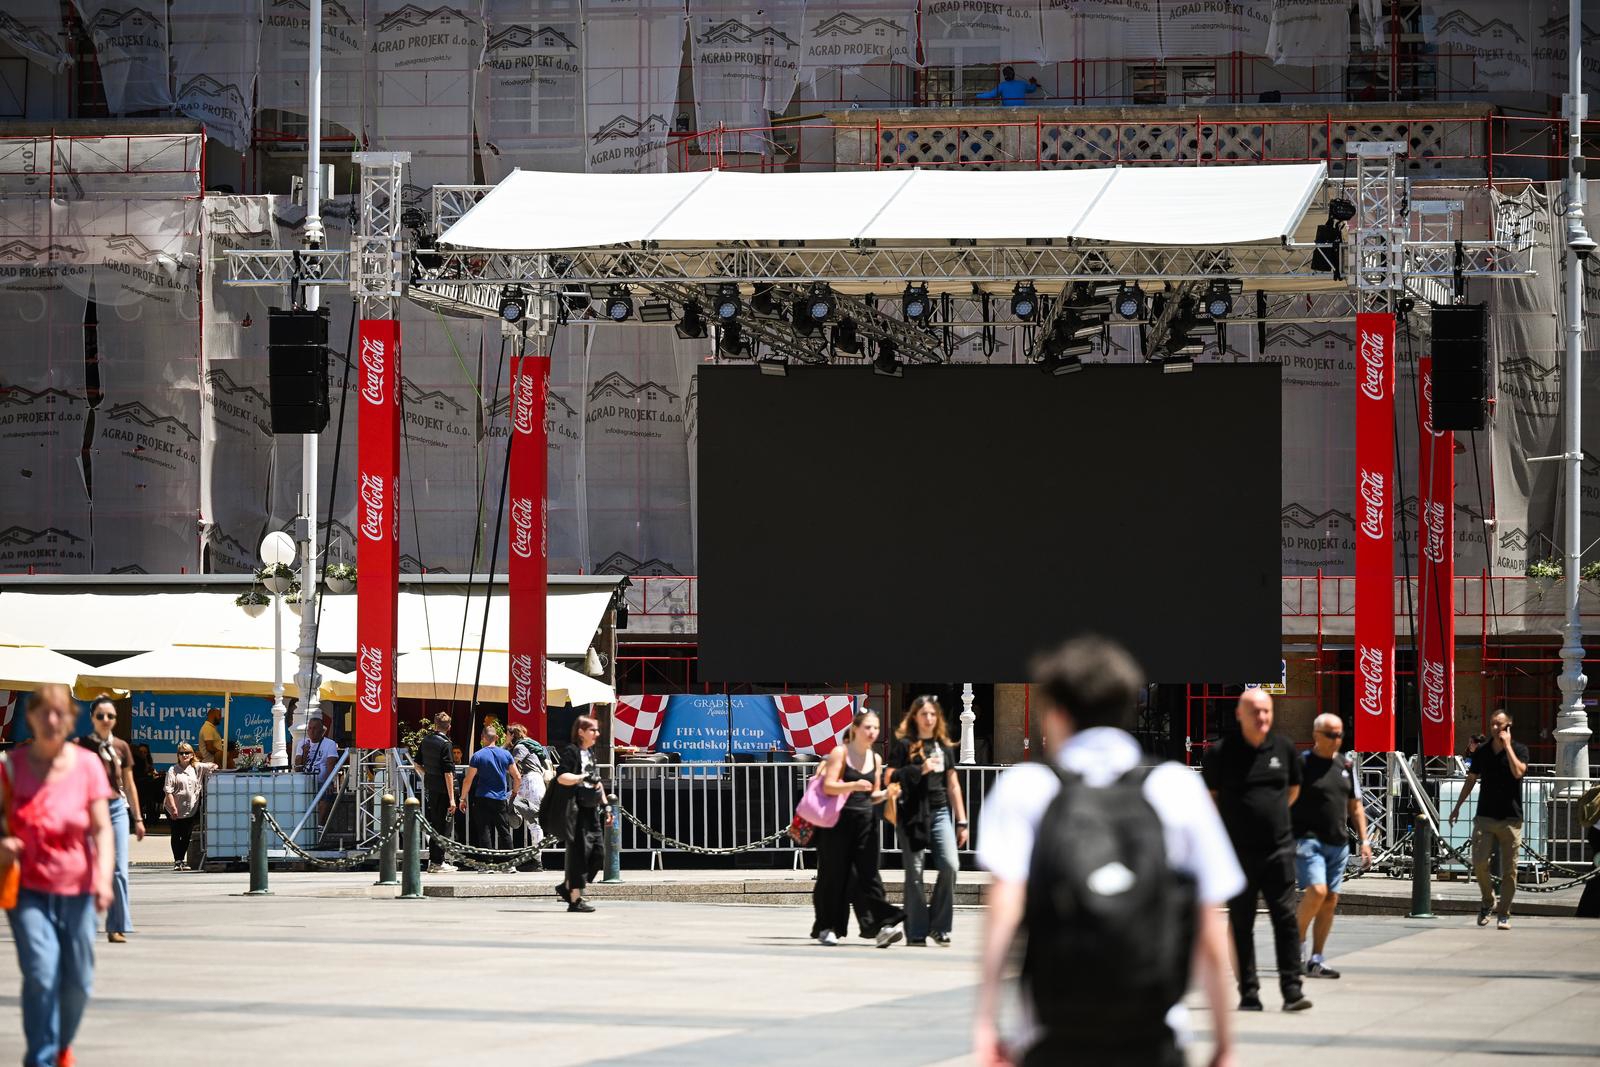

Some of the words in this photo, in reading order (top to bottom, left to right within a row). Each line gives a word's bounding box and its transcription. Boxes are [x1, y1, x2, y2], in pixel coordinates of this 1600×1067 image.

[927, 1, 960, 16] AGRAD
[963, 0, 1004, 15] PROJEKT
[1006, 6, 1032, 20] d.o.o.
[1169, 4, 1201, 21] AGRAD
[1203, 1, 1243, 15] PROJEKT
[267, 15, 299, 31] AGRAD
[339, 31, 360, 50] d.o.o.
[370, 39, 406, 54] AGRAD
[408, 34, 450, 50] PROJEKT
[453, 34, 479, 48] d.o.o.
[808, 45, 841, 57] AGRAD
[843, 43, 884, 56] PROJEKT
[515, 55, 554, 69] PROJEKT
[556, 59, 581, 74] d.o.o.
[701, 52, 733, 65] AGRAD
[735, 52, 773, 66] PROJEKT
[774, 55, 799, 71] d.o.o.
[590, 148, 622, 167] AGRAD
[19, 267, 58, 279] PROJEKT
[61, 265, 87, 277] d.o.o.
[101, 256, 130, 275] AGRAD
[132, 266, 166, 288] PROJEKT
[167, 277, 193, 293] d.o.o.
[1293, 355, 1335, 372] PROJEKT
[1498, 380, 1527, 400] AGRAD
[17, 411, 56, 424] PROJEKT
[58, 410, 84, 422] d.o.o.
[219, 399, 252, 421] PROJEKT
[585, 405, 617, 424] AGRAD
[618, 406, 658, 423] PROJEKT
[659, 411, 683, 423] d.o.o.
[406, 411, 444, 432] PROJEKT
[446, 421, 471, 437] d.o.o.
[482, 426, 511, 438] AGRA
[558, 422, 580, 441] d.o.o.
[102, 427, 134, 443] AGRAD
[136, 432, 175, 454] PROJEKT
[175, 447, 199, 466] d.o.o.
[16, 548, 57, 560] PROJEKT
[59, 550, 86, 560] d.o.o.
[1297, 537, 1339, 552] PROJEKT
[677, 727, 702, 737] FIFA
[705, 727, 740, 737] Word
[741, 727, 764, 739] Cup
[662, 741, 671, 750] u
[673, 739, 730, 751] Gradskoj
